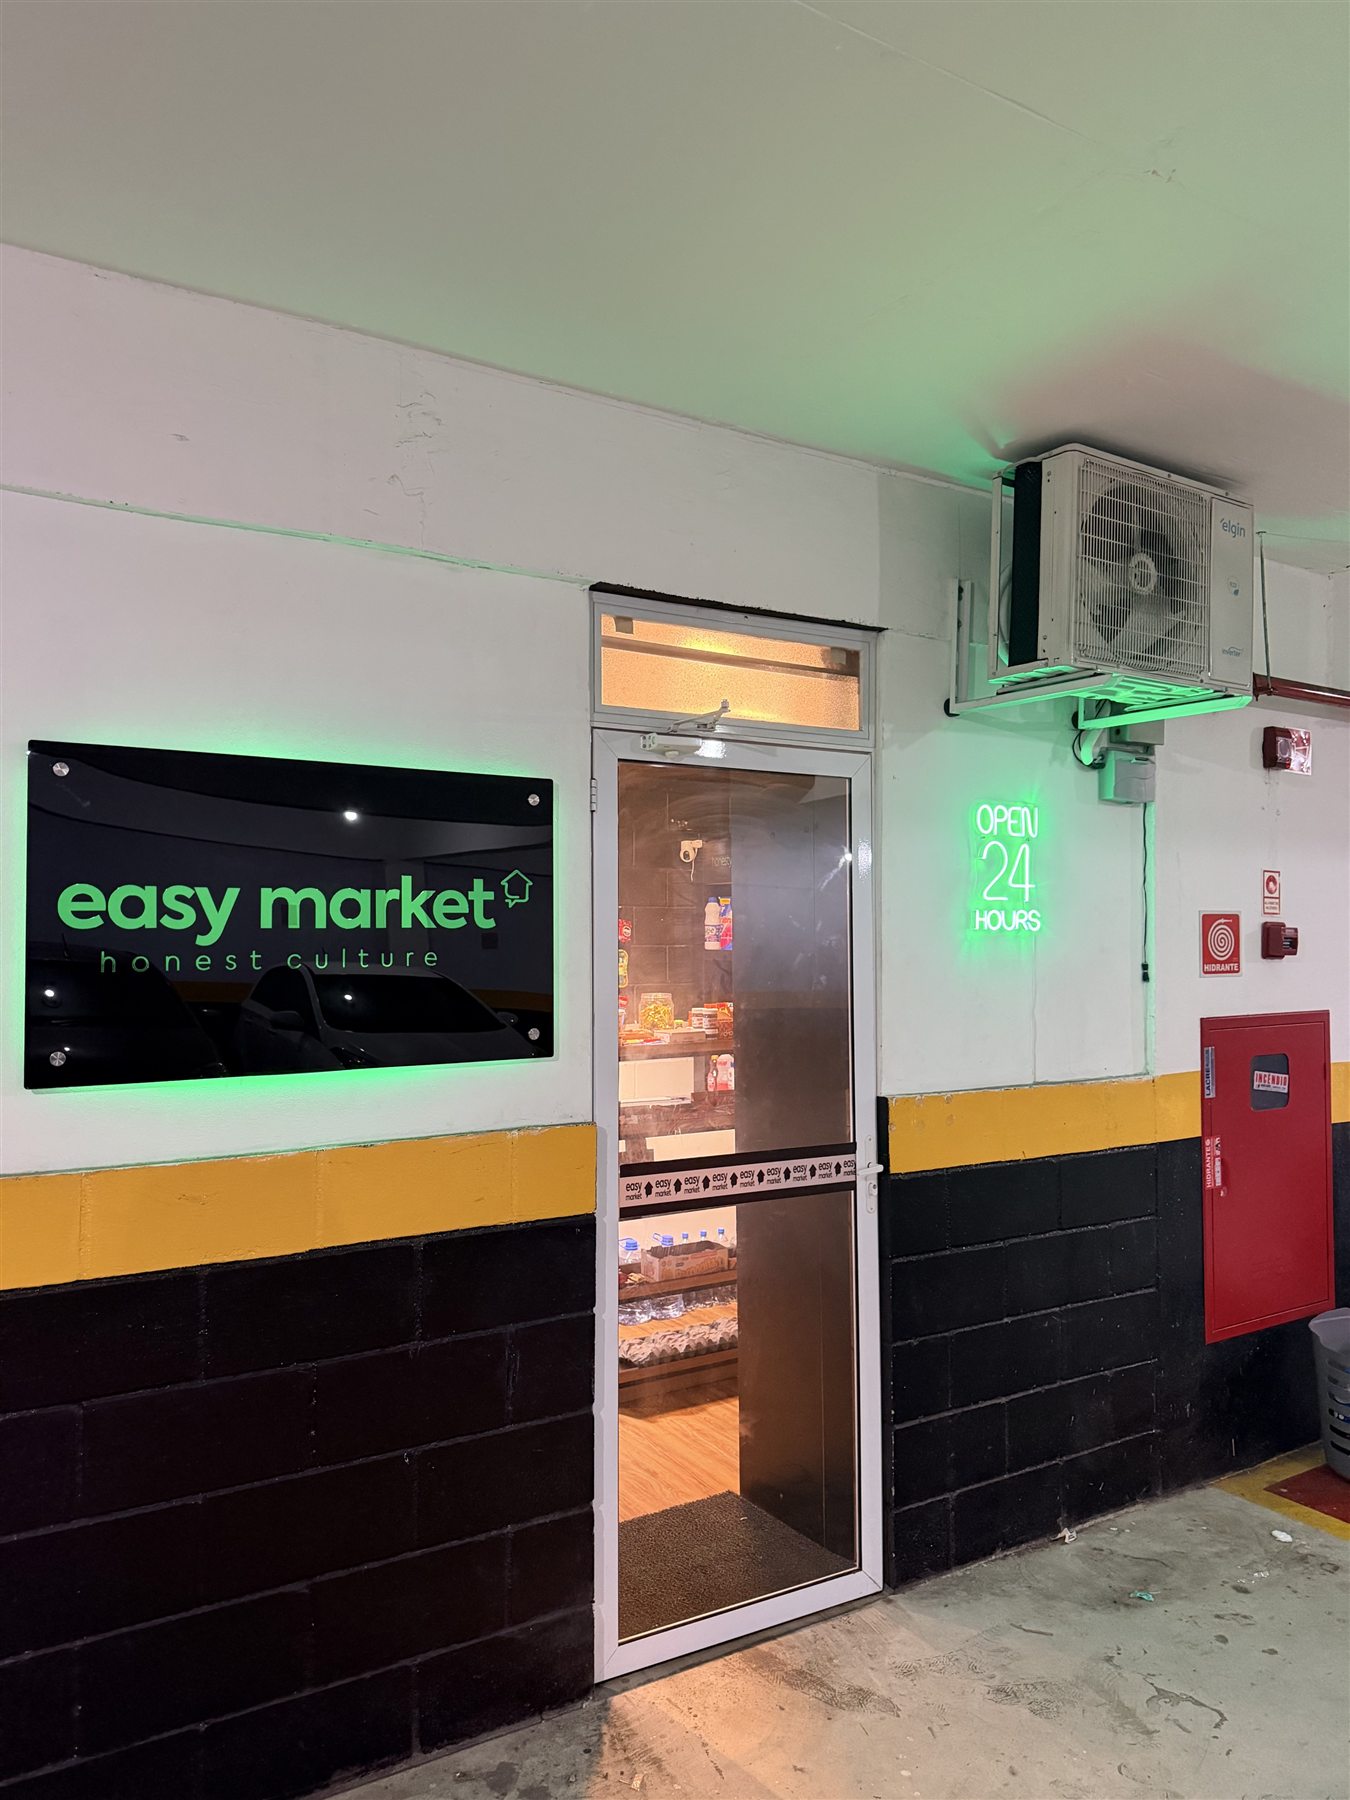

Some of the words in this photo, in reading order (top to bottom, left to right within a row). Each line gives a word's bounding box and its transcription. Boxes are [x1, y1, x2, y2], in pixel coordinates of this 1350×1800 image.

[1222, 520, 1246, 538] elgin
[976, 804, 1038, 838] OPEN
[982, 840, 1036, 902] 24
[57, 882, 240, 947] easy
[259, 874, 496, 930] market
[975, 909, 1041, 932] HOURS
[100, 950, 262, 973] honest
[286, 948, 438, 969] culture
[1203, 963, 1239, 972] HIDRANTE
[767, 1166, 781, 1177] easy
[793, 1163, 807, 1175] easy
[819, 1161, 833, 1172] easy
[712, 1172, 728, 1183] easy
[740, 1169, 755, 1180] easy
[625, 1181, 642, 1193] easy
[655, 1178, 671, 1190] easy
[684, 1175, 700, 1187] easy
[712, 1183, 728, 1191] market
[740, 1180, 755, 1188] market
[625, 1193, 642, 1201] market
